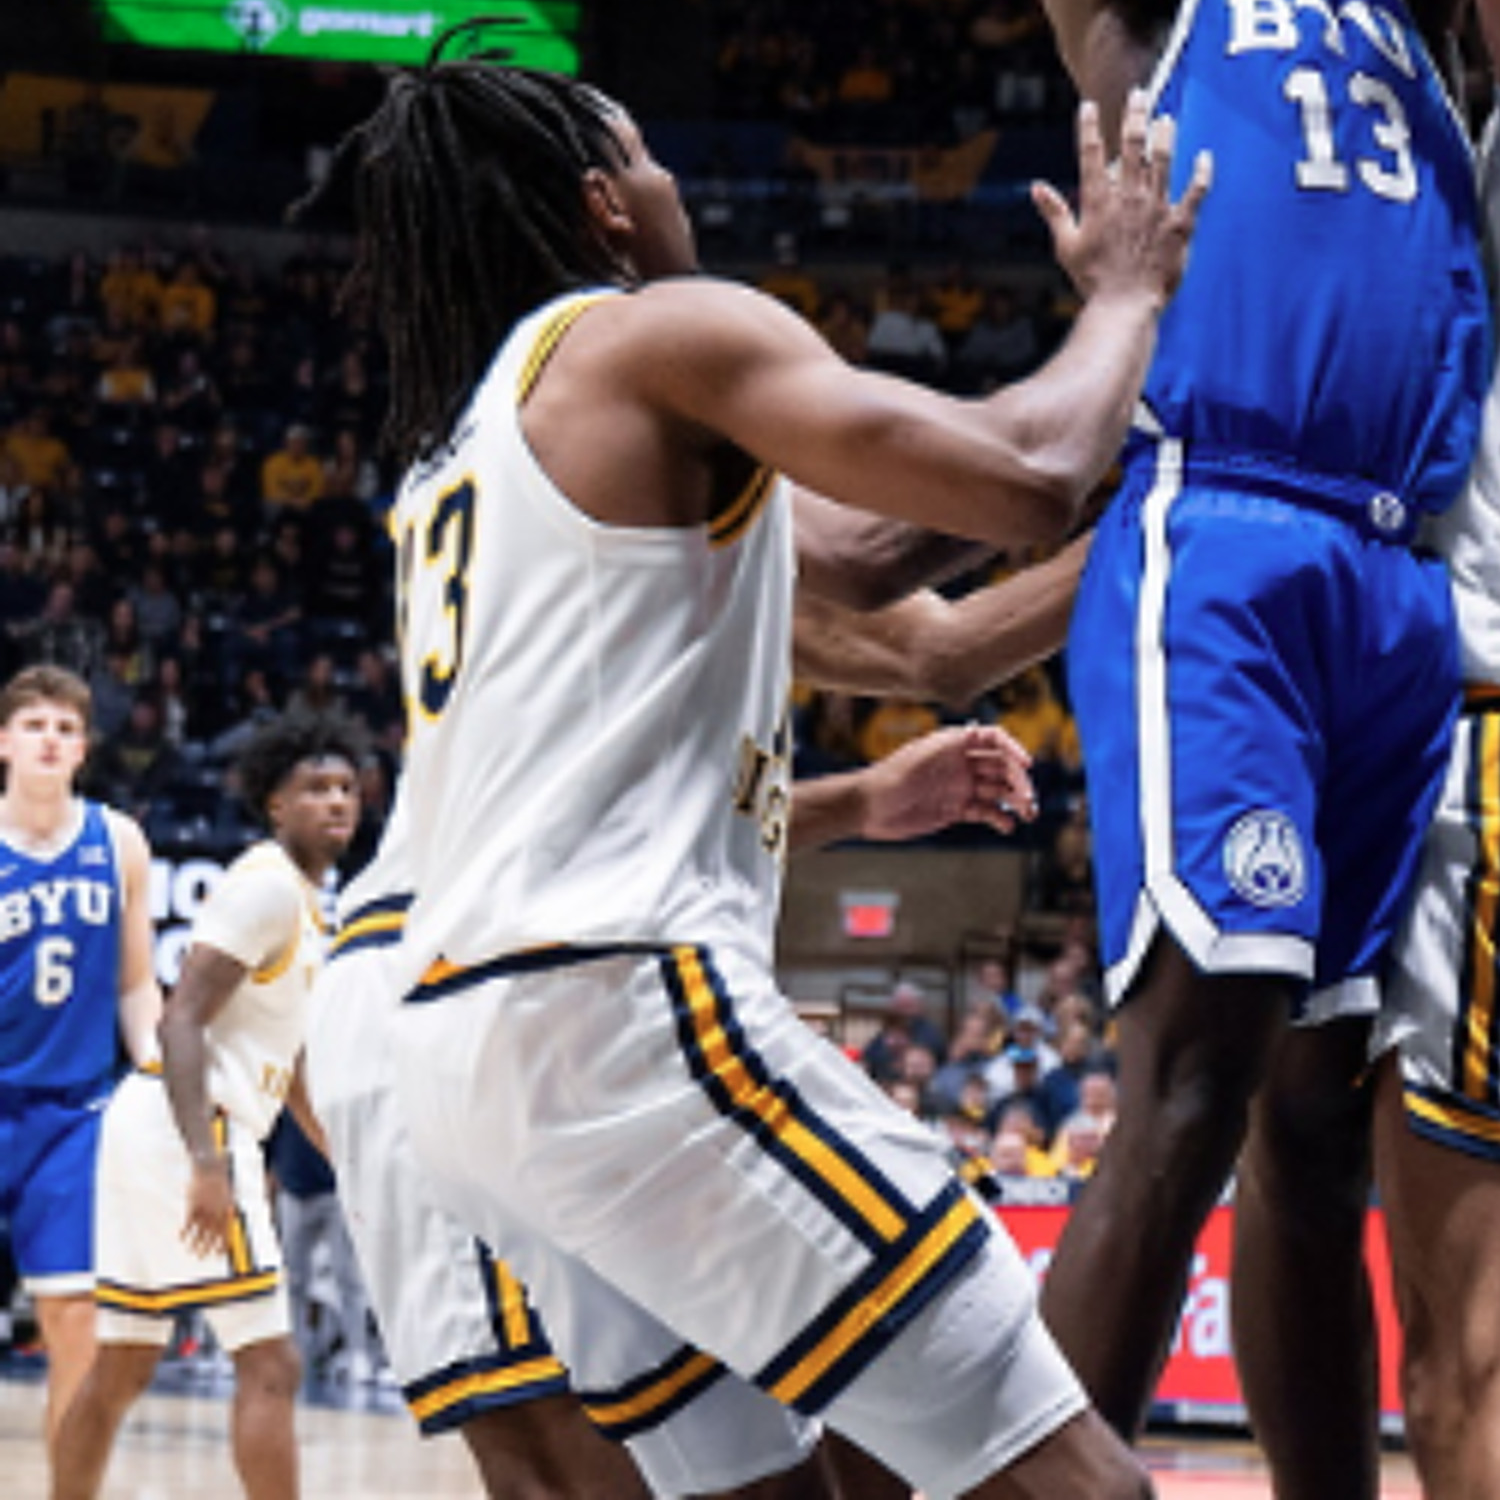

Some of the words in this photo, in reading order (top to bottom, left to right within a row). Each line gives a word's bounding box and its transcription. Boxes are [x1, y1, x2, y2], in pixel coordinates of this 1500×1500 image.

[1284, 67, 1417, 203] 13
[0, 875, 113, 943] BYU
[33, 933, 76, 1008] 6
